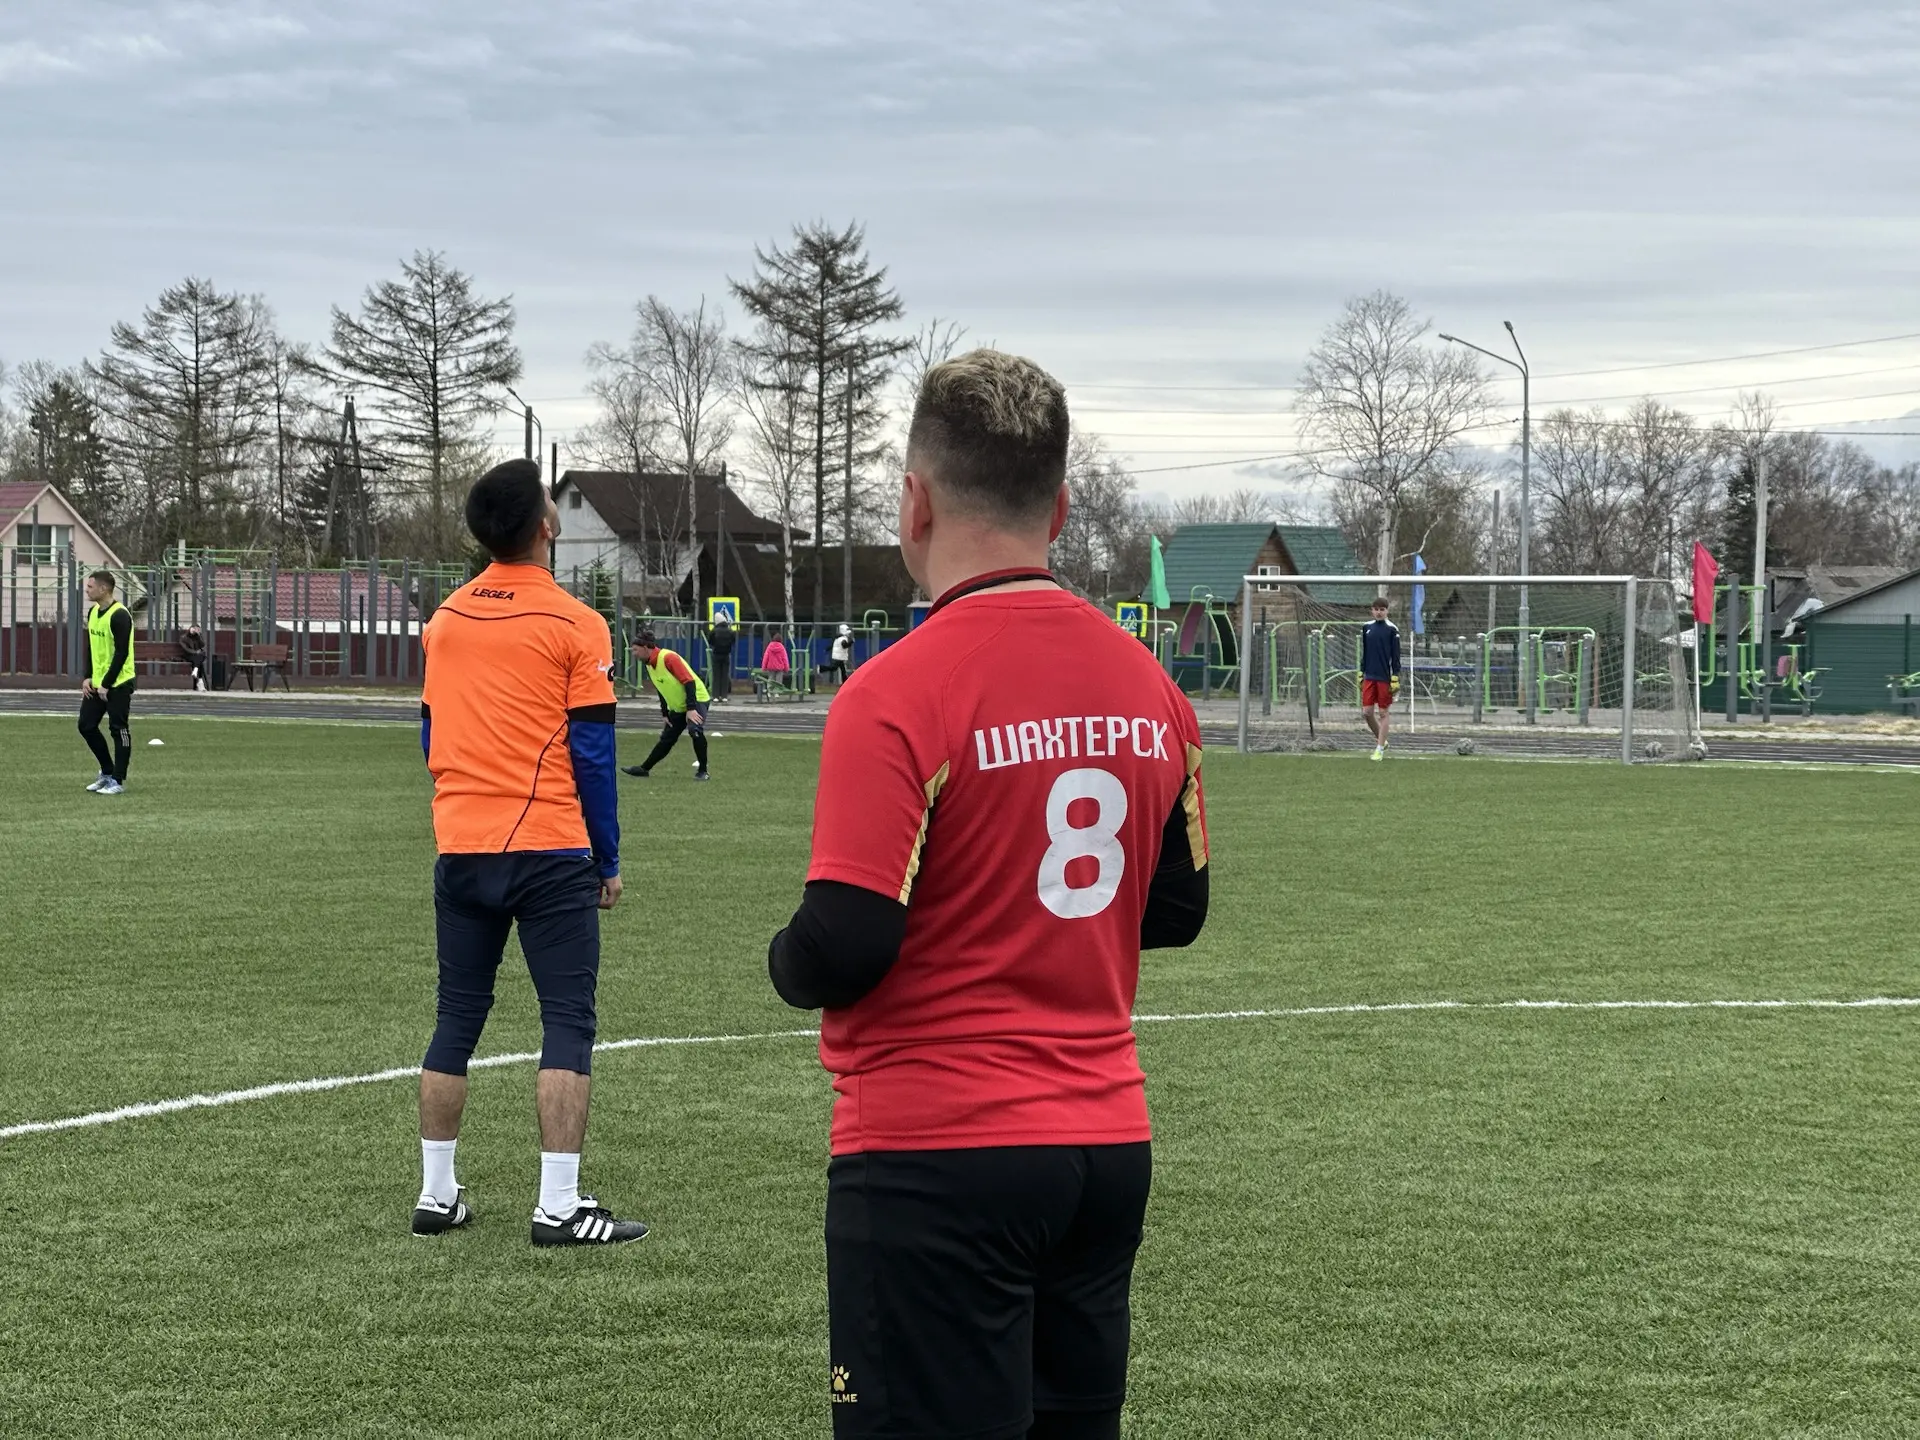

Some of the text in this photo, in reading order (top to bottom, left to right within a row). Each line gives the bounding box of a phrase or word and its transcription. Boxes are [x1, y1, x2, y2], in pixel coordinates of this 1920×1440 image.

[470, 587, 515, 601] LEGEA
[974, 716, 1169, 771] ШАХТЕРСК
[1037, 767, 1128, 919] 8
[832, 1393, 858, 1403] ELME
